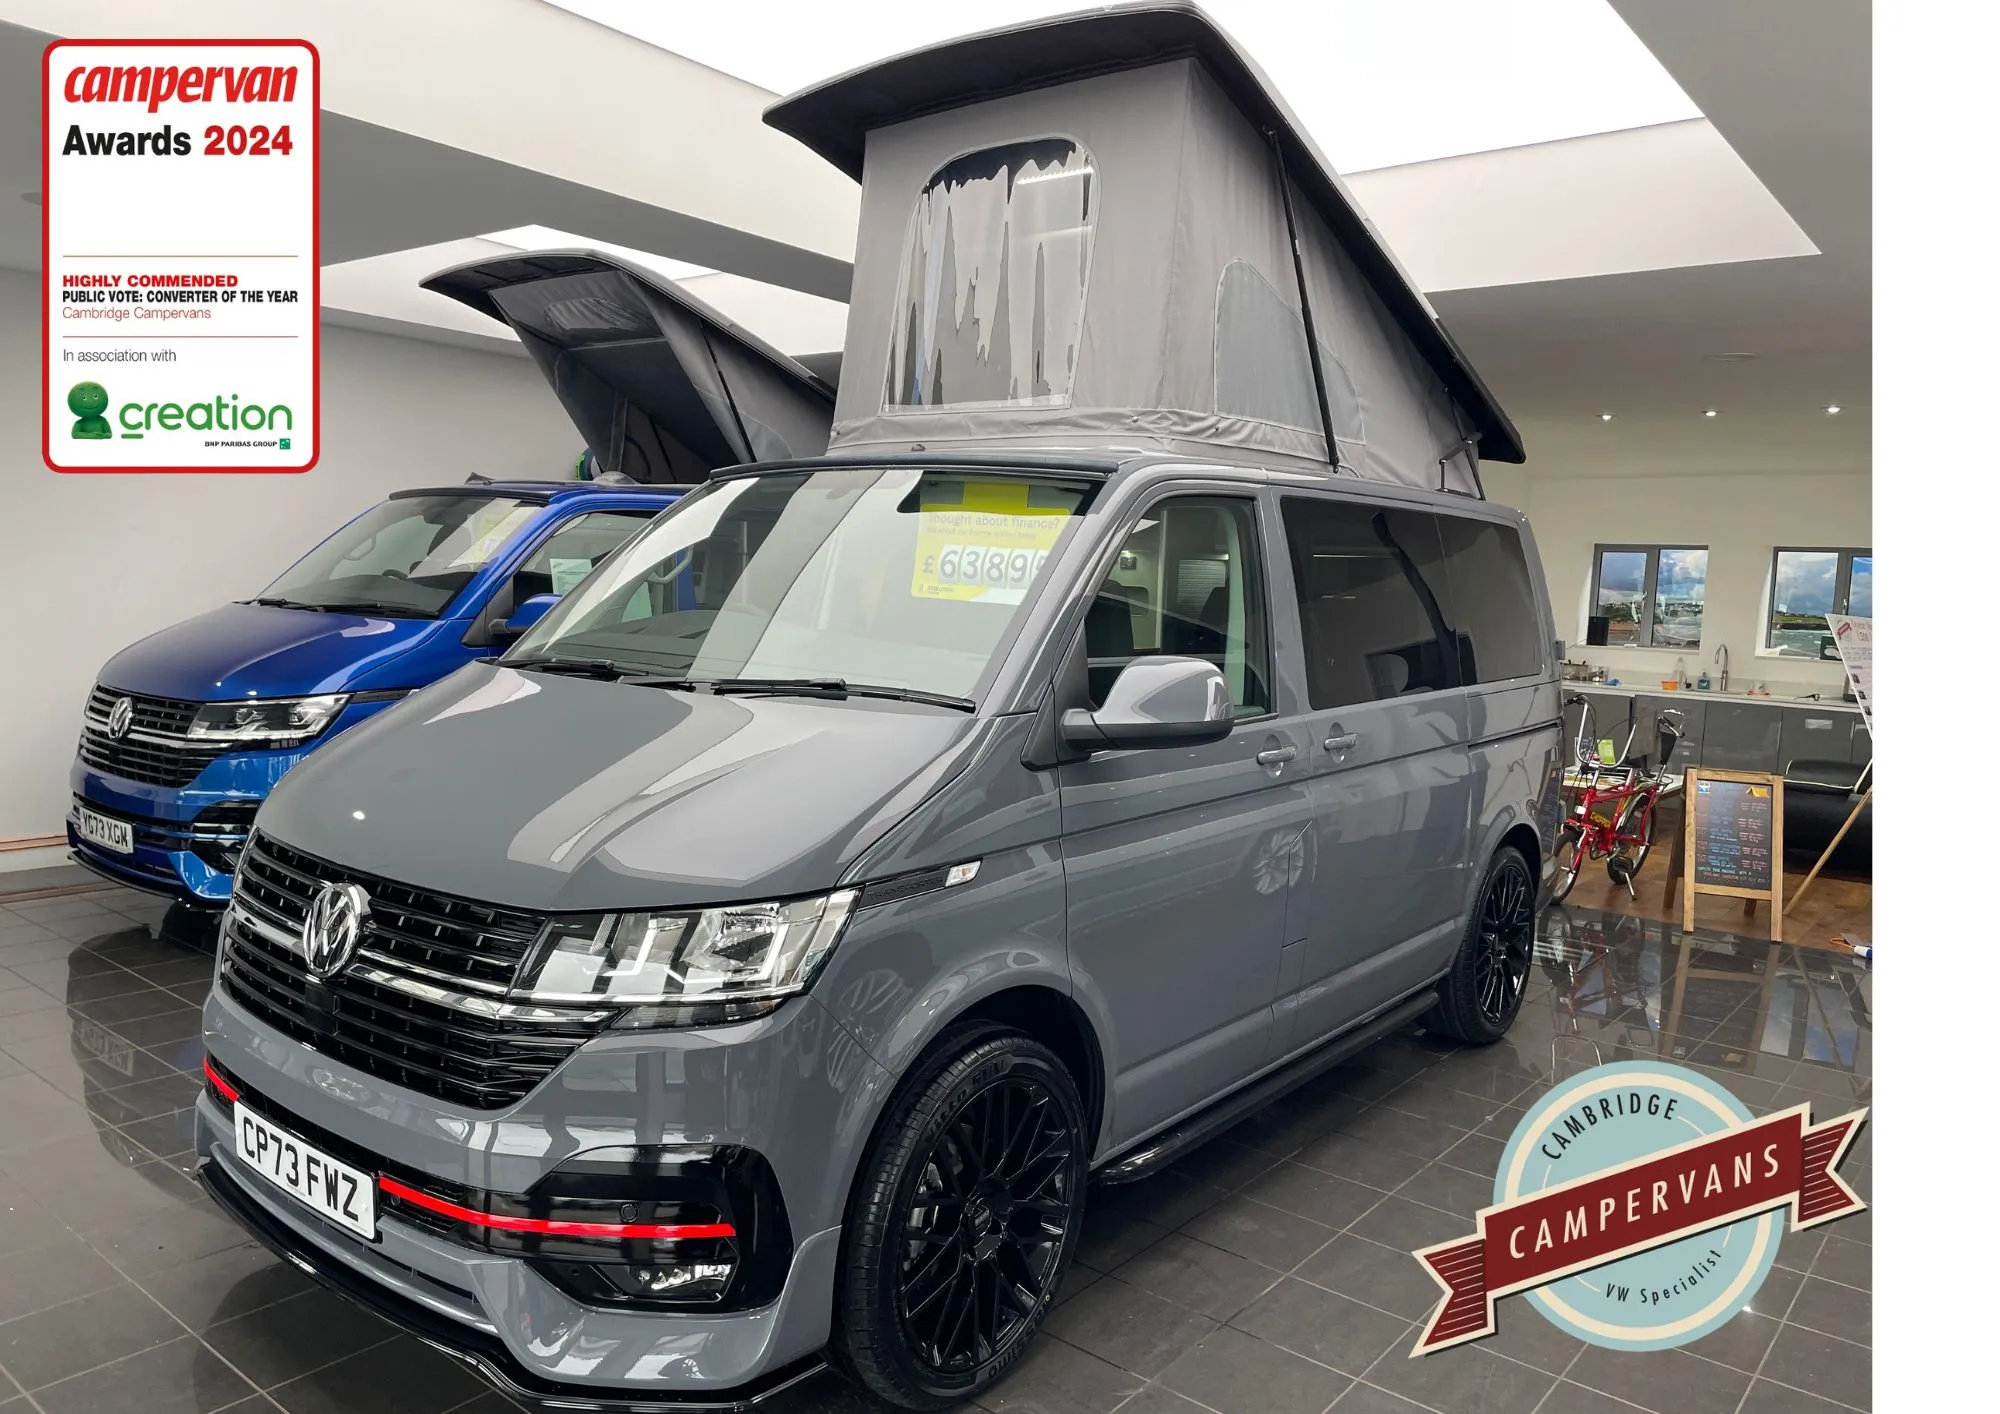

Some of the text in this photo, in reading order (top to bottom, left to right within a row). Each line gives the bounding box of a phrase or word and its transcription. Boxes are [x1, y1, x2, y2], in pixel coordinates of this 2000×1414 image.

[975, 514, 1009, 528] about
[1011, 516, 1060, 530] finance?
[922, 555, 935, 574] £
[82, 811, 105, 840] YG73
[243, 1116, 359, 1222] CP73 FWZ
